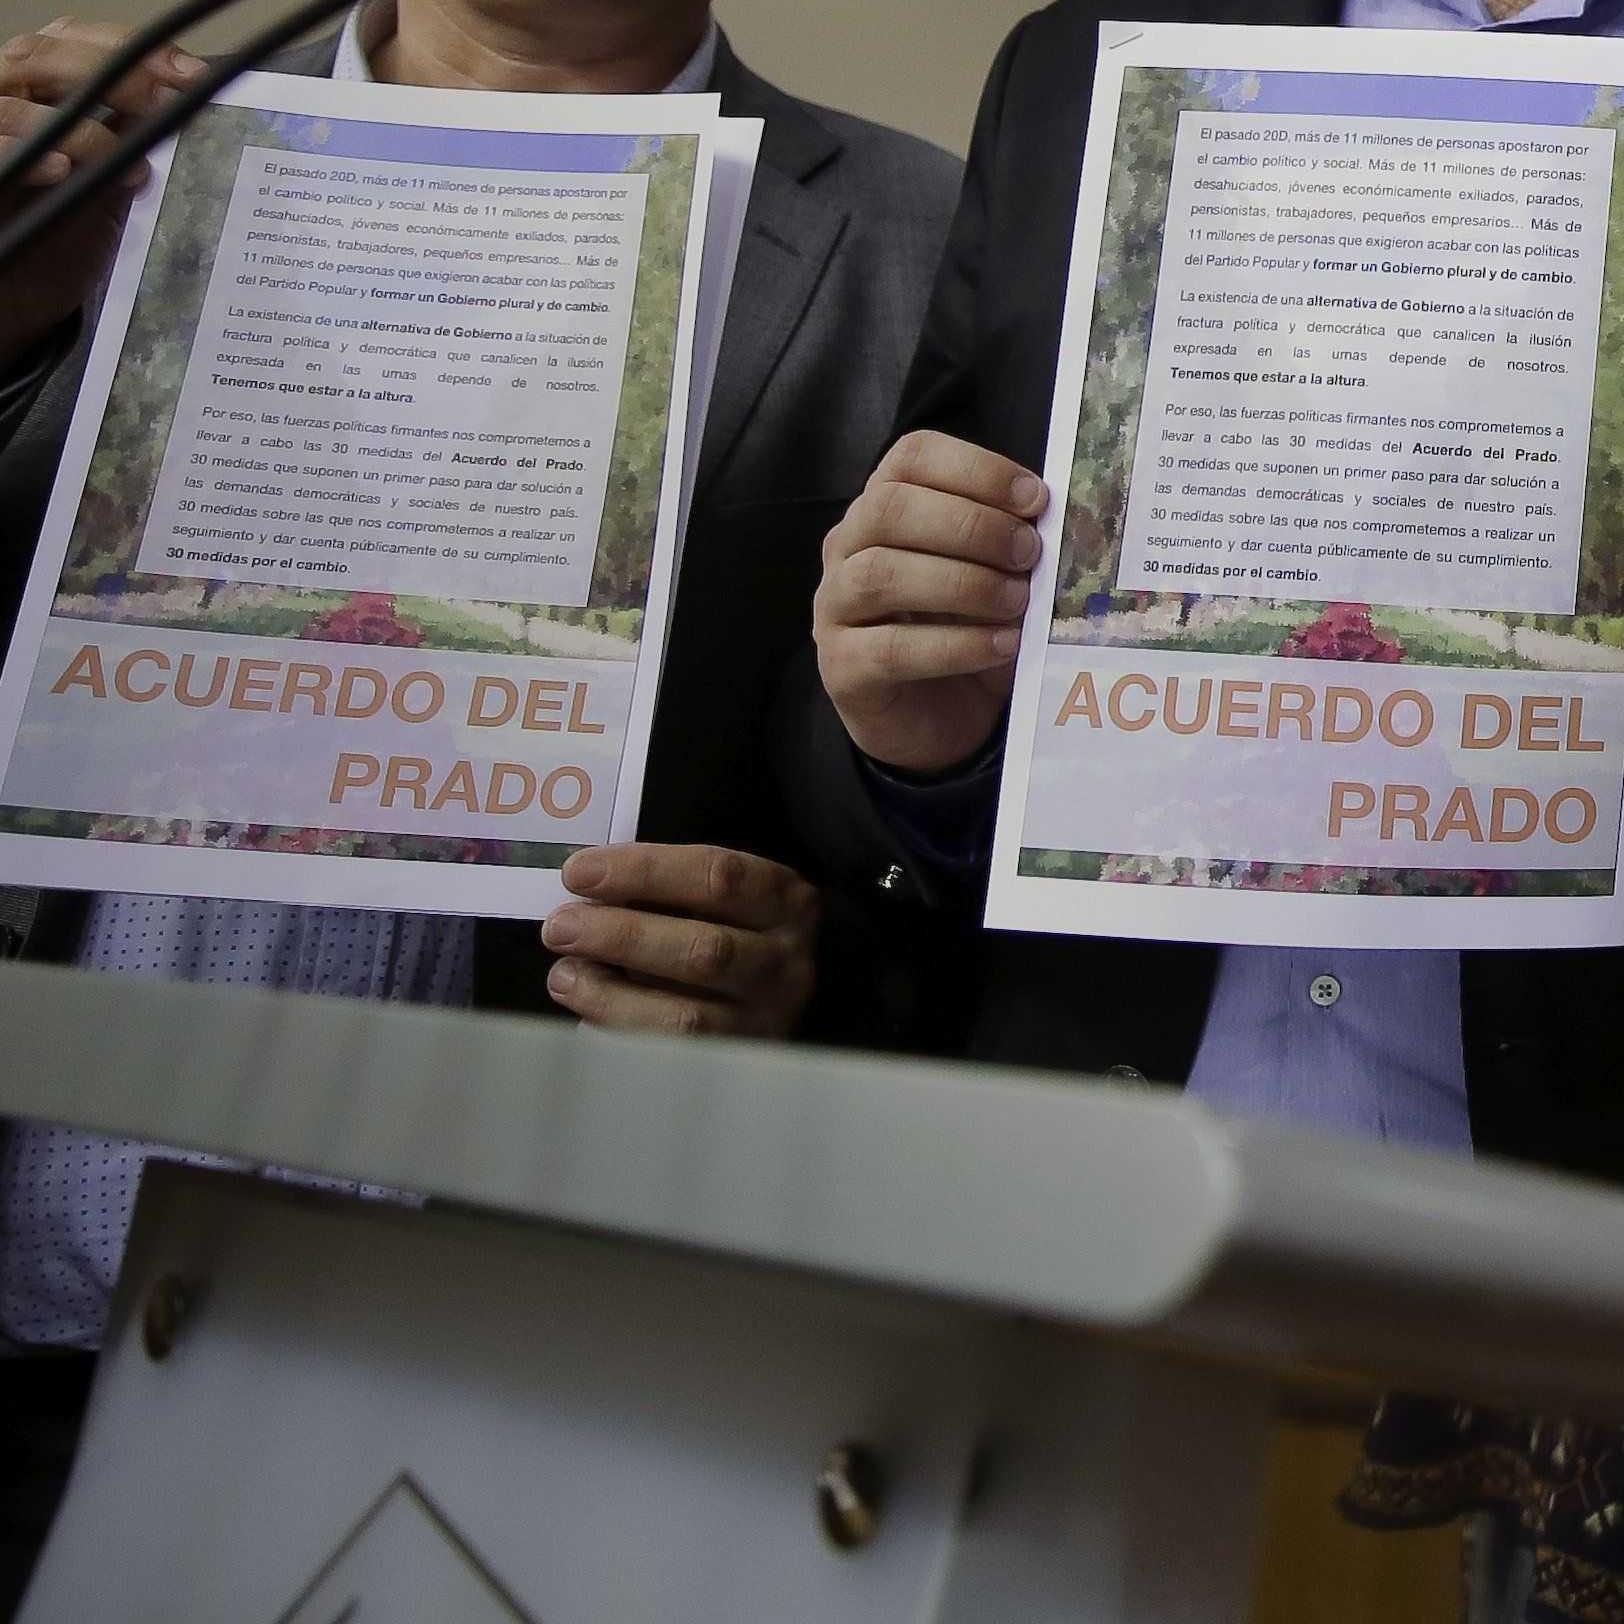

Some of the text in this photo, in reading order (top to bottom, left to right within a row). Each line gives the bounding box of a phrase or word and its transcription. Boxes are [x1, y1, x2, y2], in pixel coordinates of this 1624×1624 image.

[1199, 126, 1212, 139] El
[1213, 128, 1261, 143] pasado
[1293, 129, 1321, 143] más
[1322, 130, 1340, 143] de
[1343, 131, 1357, 144] 11
[1361, 132, 1414, 146] millones
[1415, 135, 1433, 148] de
[1434, 137, 1495, 151] personas
[1497, 140, 1566, 154] apostaron
[1565, 144, 1590, 158] por
[1196, 151, 1209, 164] el
[1211, 151, 1258, 166] cambio
[1261, 153, 1306, 169] político
[1310, 158, 1319, 170] y
[1367, 157, 1395, 172] Más
[1399, 159, 1417, 172] de
[1422, 160, 1436, 173] 11
[1441, 161, 1495, 176] millones
[1499, 164, 1517, 177] de
[1286, 179, 1336, 195] jóvenes
[1341, 182, 1452, 199] económicamente
[1361, 210, 1426, 225] pequeños
[1530, 215, 1559, 231] Más
[1564, 219, 1582, 233] de
[1188, 227, 1580, 260] 11 millones de personas que exigieron acabar con las políticas
[1183, 253, 1203, 265] del
[1205, 253, 1250, 267] Partido
[1251, 255, 1301, 270] Popular
[1302, 260, 1310, 272] y
[1312, 257, 1358, 271] formar
[1360, 262, 1378, 272] un
[1380, 260, 1444, 276] Gobierno
[1446, 264, 1486, 279] plural
[1488, 269, 1498, 281] y
[1499, 267, 1518, 280] de
[50, 643, 606, 734] ACUERDO DEL
[1054, 671, 1606, 752] ACUERDO DEL
[328, 752, 593, 820] PRADO
[1327, 781, 1598, 844] PRADO
